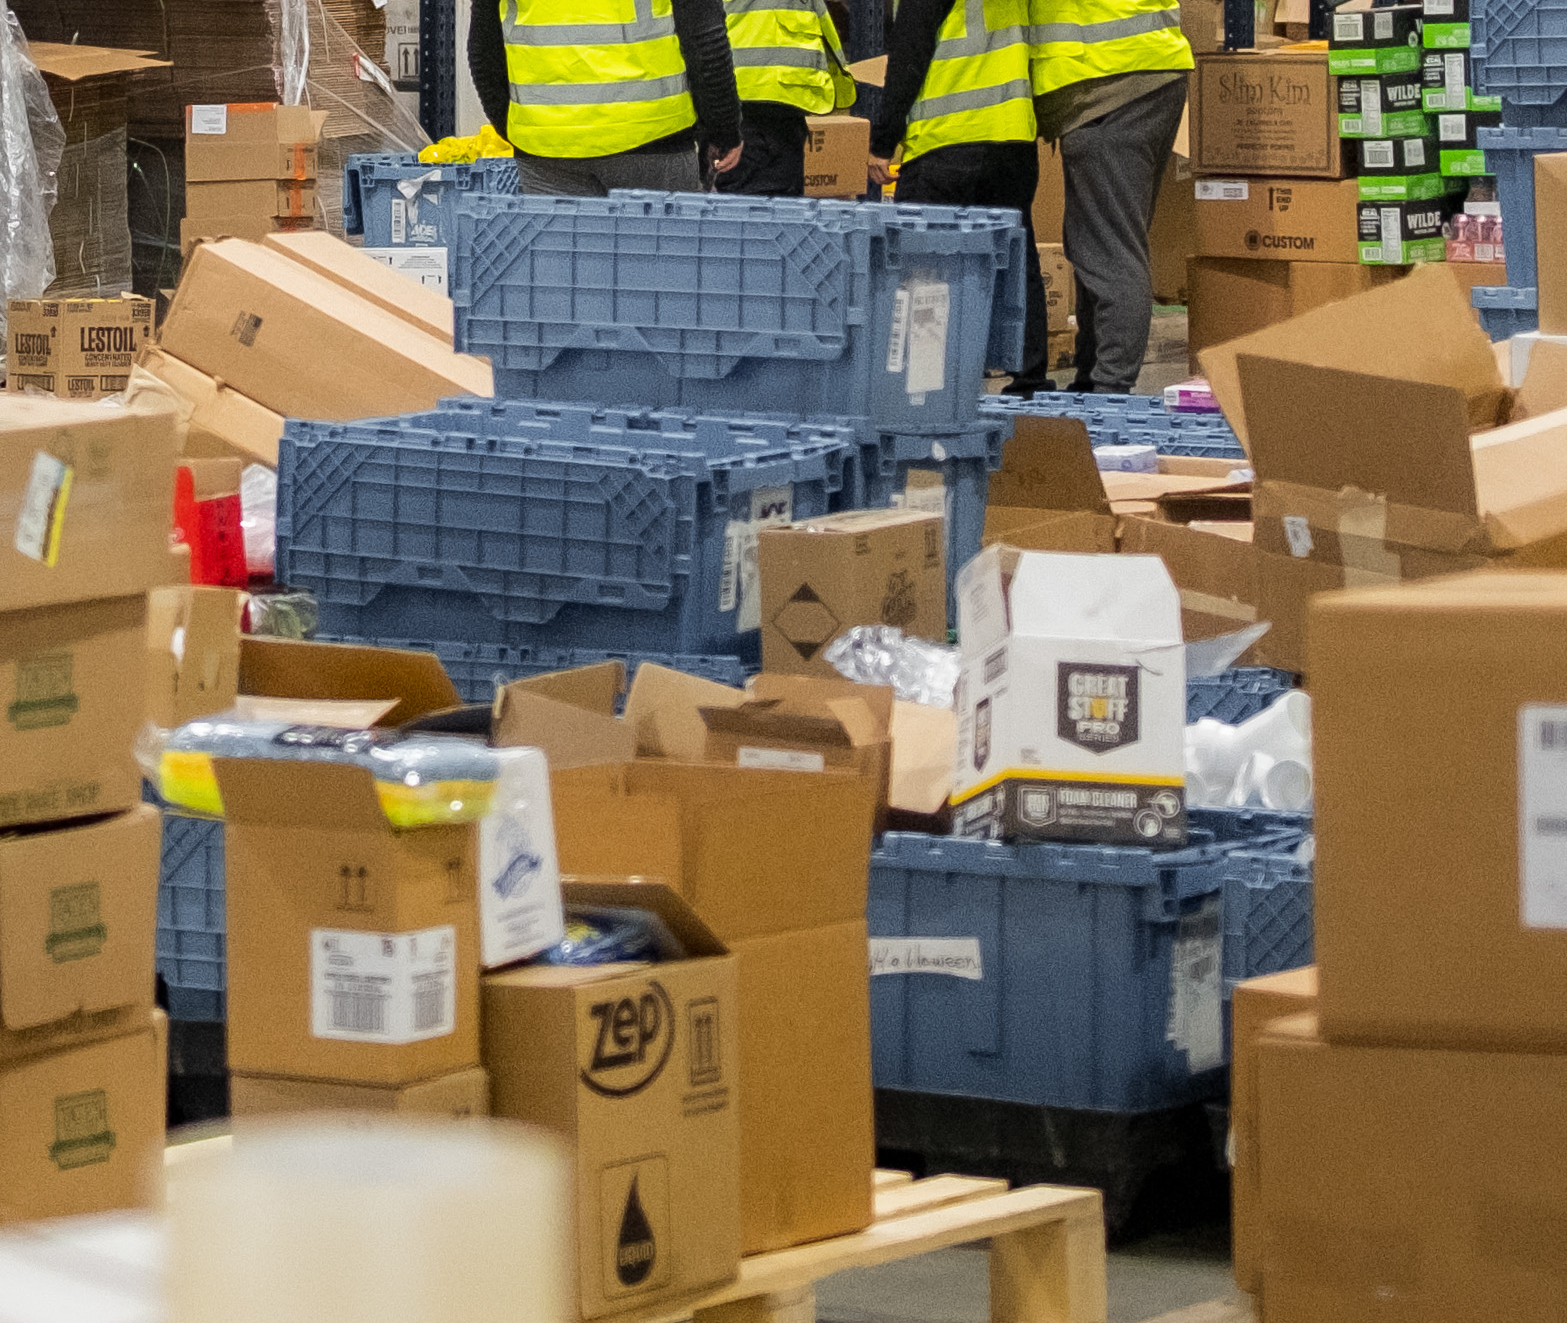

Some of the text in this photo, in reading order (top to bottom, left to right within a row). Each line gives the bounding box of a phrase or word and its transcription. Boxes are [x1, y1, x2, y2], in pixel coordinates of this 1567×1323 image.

[1386, 83, 1421, 101] WILDE
[1407, 211, 1441, 228] WILDE
[1262, 234, 1315, 250] CUSTOM
[15, 333, 52, 356] LESTOIL
[80, 326, 137, 353] LESTOIL
[1067, 672, 1130, 697] GREAT
[1075, 720, 1121, 735] PRO
